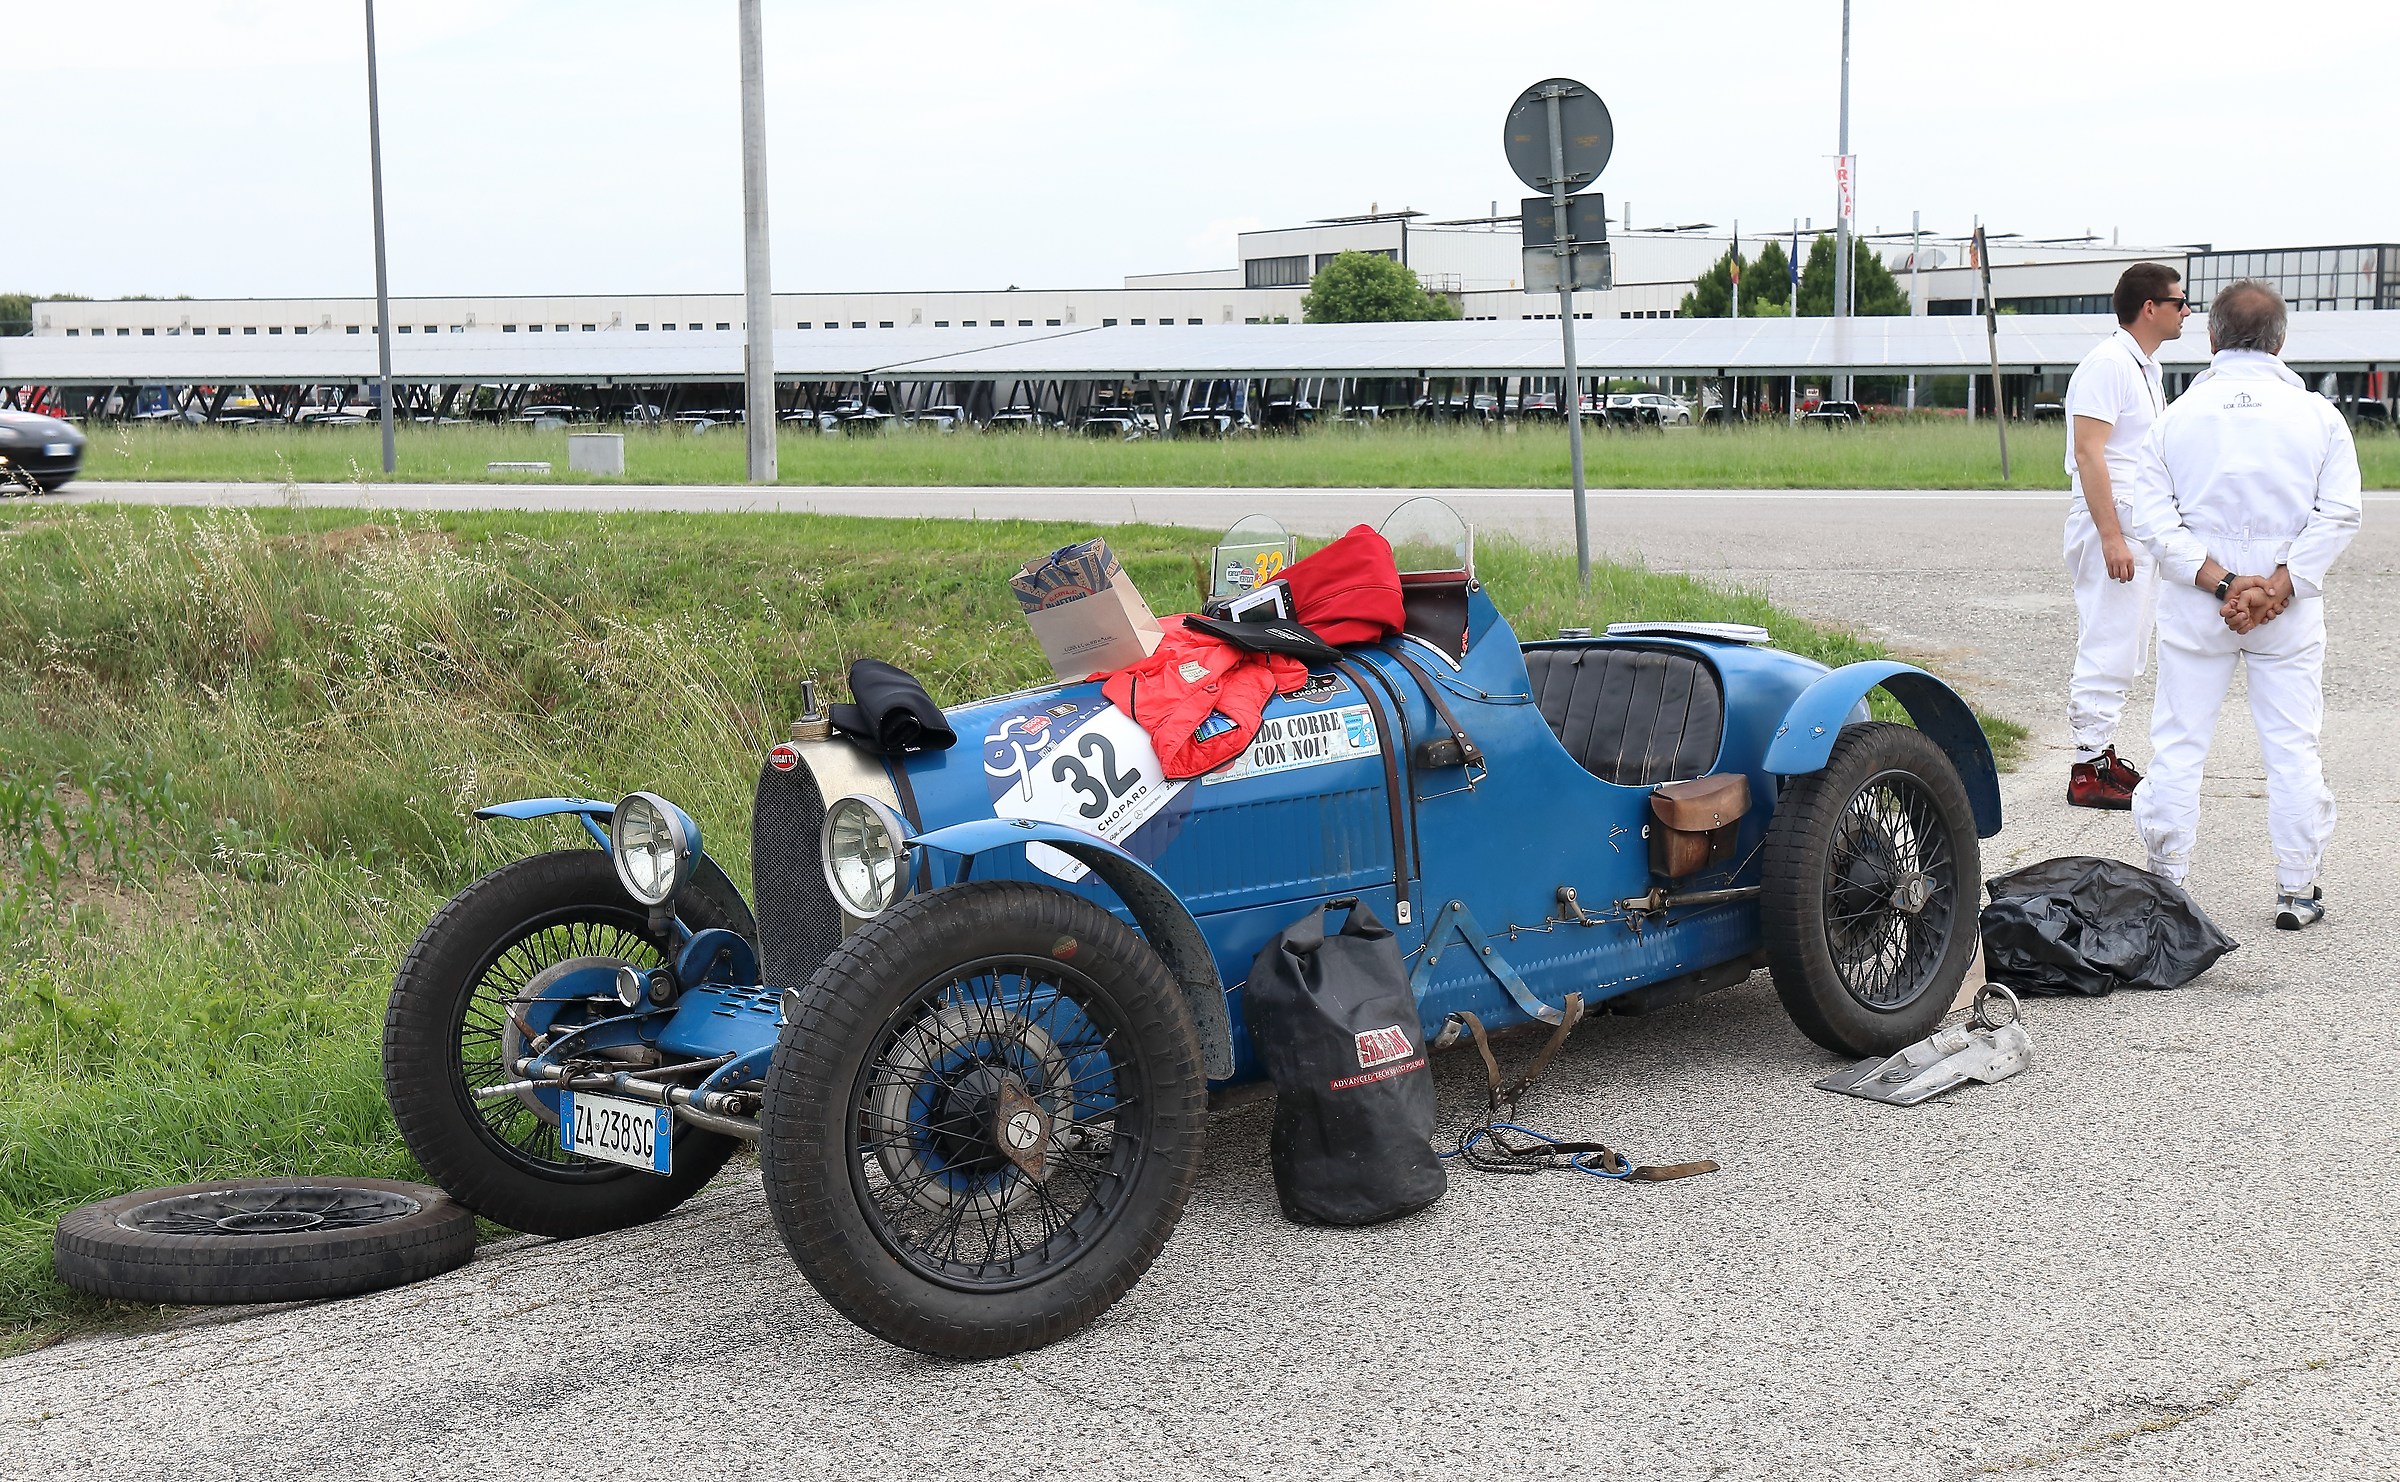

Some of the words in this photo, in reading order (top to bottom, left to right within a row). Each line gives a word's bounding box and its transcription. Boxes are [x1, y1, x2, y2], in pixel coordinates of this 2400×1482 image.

[1253, 550, 1284, 589] 32
[1292, 685, 1337, 698] CHOPARD
[1287, 712, 1341, 738] CORRE
[771, 754, 795, 764] BUGATTI
[1254, 743, 1286, 767] CON
[1292, 735, 1329, 760] NOI!
[1052, 733, 1141, 819] 32
[1097, 785, 1148, 832] CHOPARD
[1359, 1029, 1412, 1063] SLAM
[1333, 1074, 1372, 1088] ADVANCED
